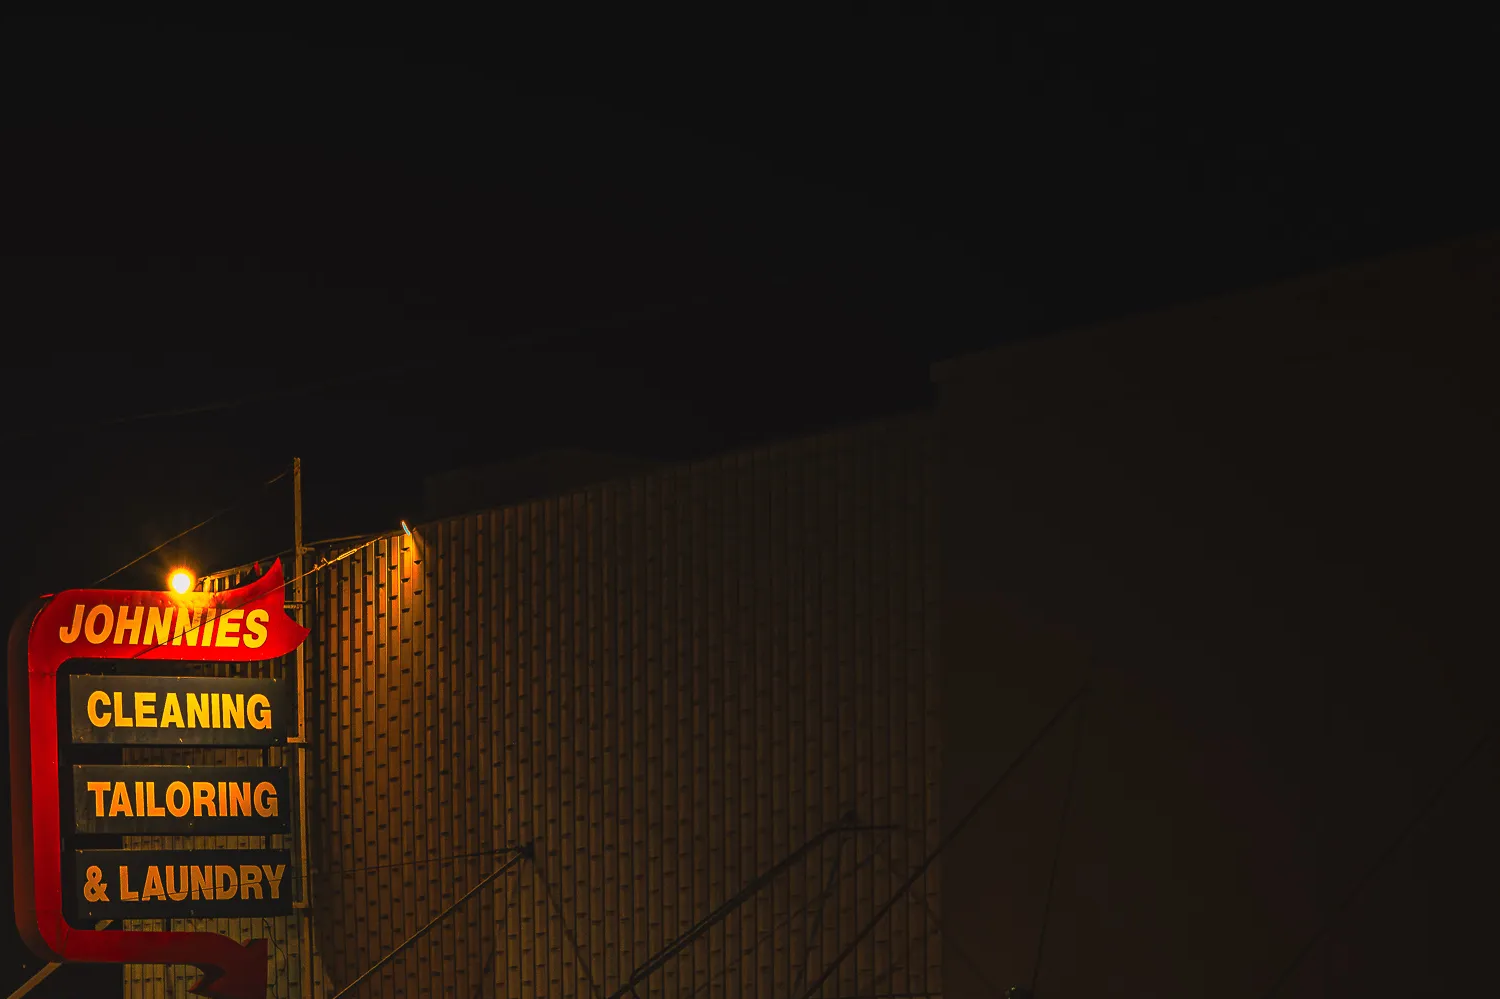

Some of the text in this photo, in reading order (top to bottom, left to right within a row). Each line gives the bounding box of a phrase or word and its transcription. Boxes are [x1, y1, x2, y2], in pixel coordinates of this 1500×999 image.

[59, 604, 269, 649] JOHNNIES
[87, 690, 272, 729] CLEANING
[87, 781, 278, 818] TAILORING
[83, 864, 286, 903] & LAUNDRY
